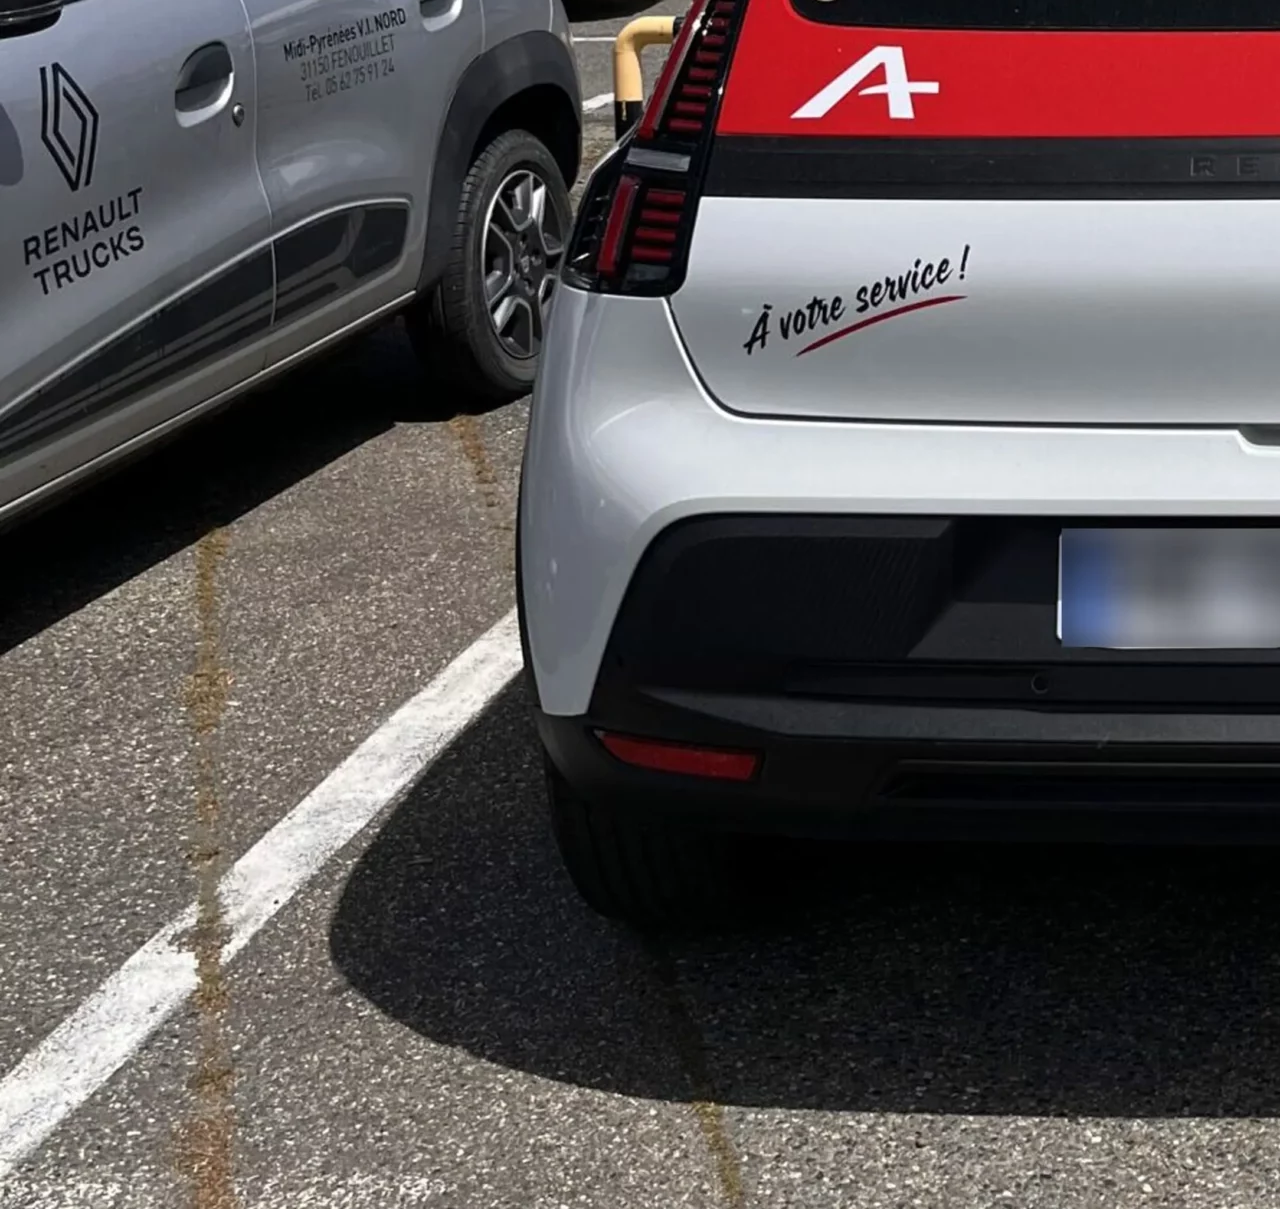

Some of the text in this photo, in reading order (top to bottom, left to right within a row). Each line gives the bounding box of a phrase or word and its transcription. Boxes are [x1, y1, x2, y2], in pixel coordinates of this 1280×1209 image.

[283, 24, 356, 62] Midi-Pyrénées
[374, 8, 407, 32] NORD
[300, 33, 396, 81] 31150 FENOUILLET
[325, 74, 338, 95] 05
[340, 71, 351, 91] 62
[352, 65, 366, 85] 75
[367, 61, 379, 82] 91
[381, 57, 395, 77] 24
[790, 45, 940, 119] A
[23, 187, 143, 266] RENAULT
[33, 225, 144, 295] TRUCKS
[780, 295, 847, 340] votre
[856, 257, 955, 313] service
